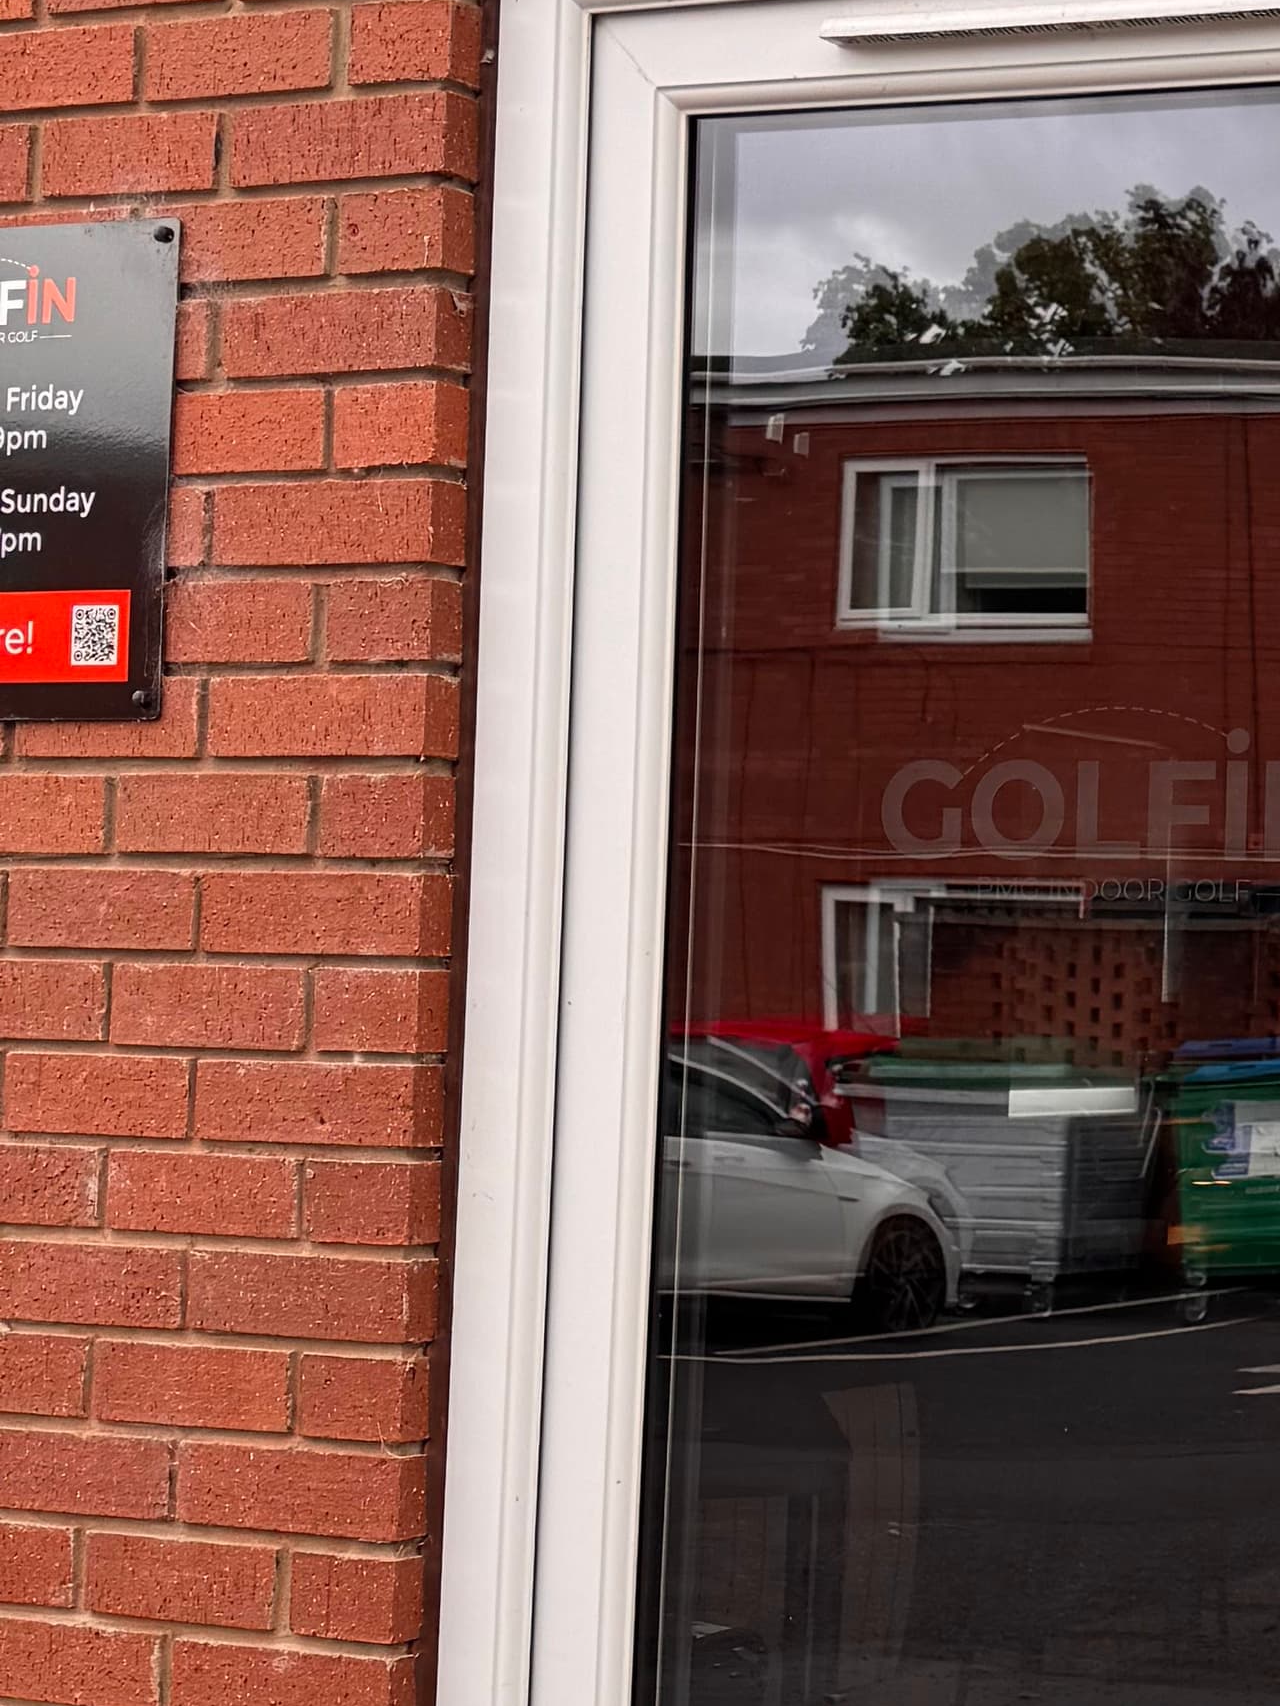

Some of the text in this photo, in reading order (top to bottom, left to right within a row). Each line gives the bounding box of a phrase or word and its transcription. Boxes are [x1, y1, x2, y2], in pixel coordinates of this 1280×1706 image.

[8, 330, 38, 343] GOLF
[6, 383, 84, 415] Friday
[0, 485, 96, 518] Sunday
[0, 528, 42, 558] pm
[1050, 878, 1165, 902] INDOOR
[1175, 879, 1250, 902] GOLF
